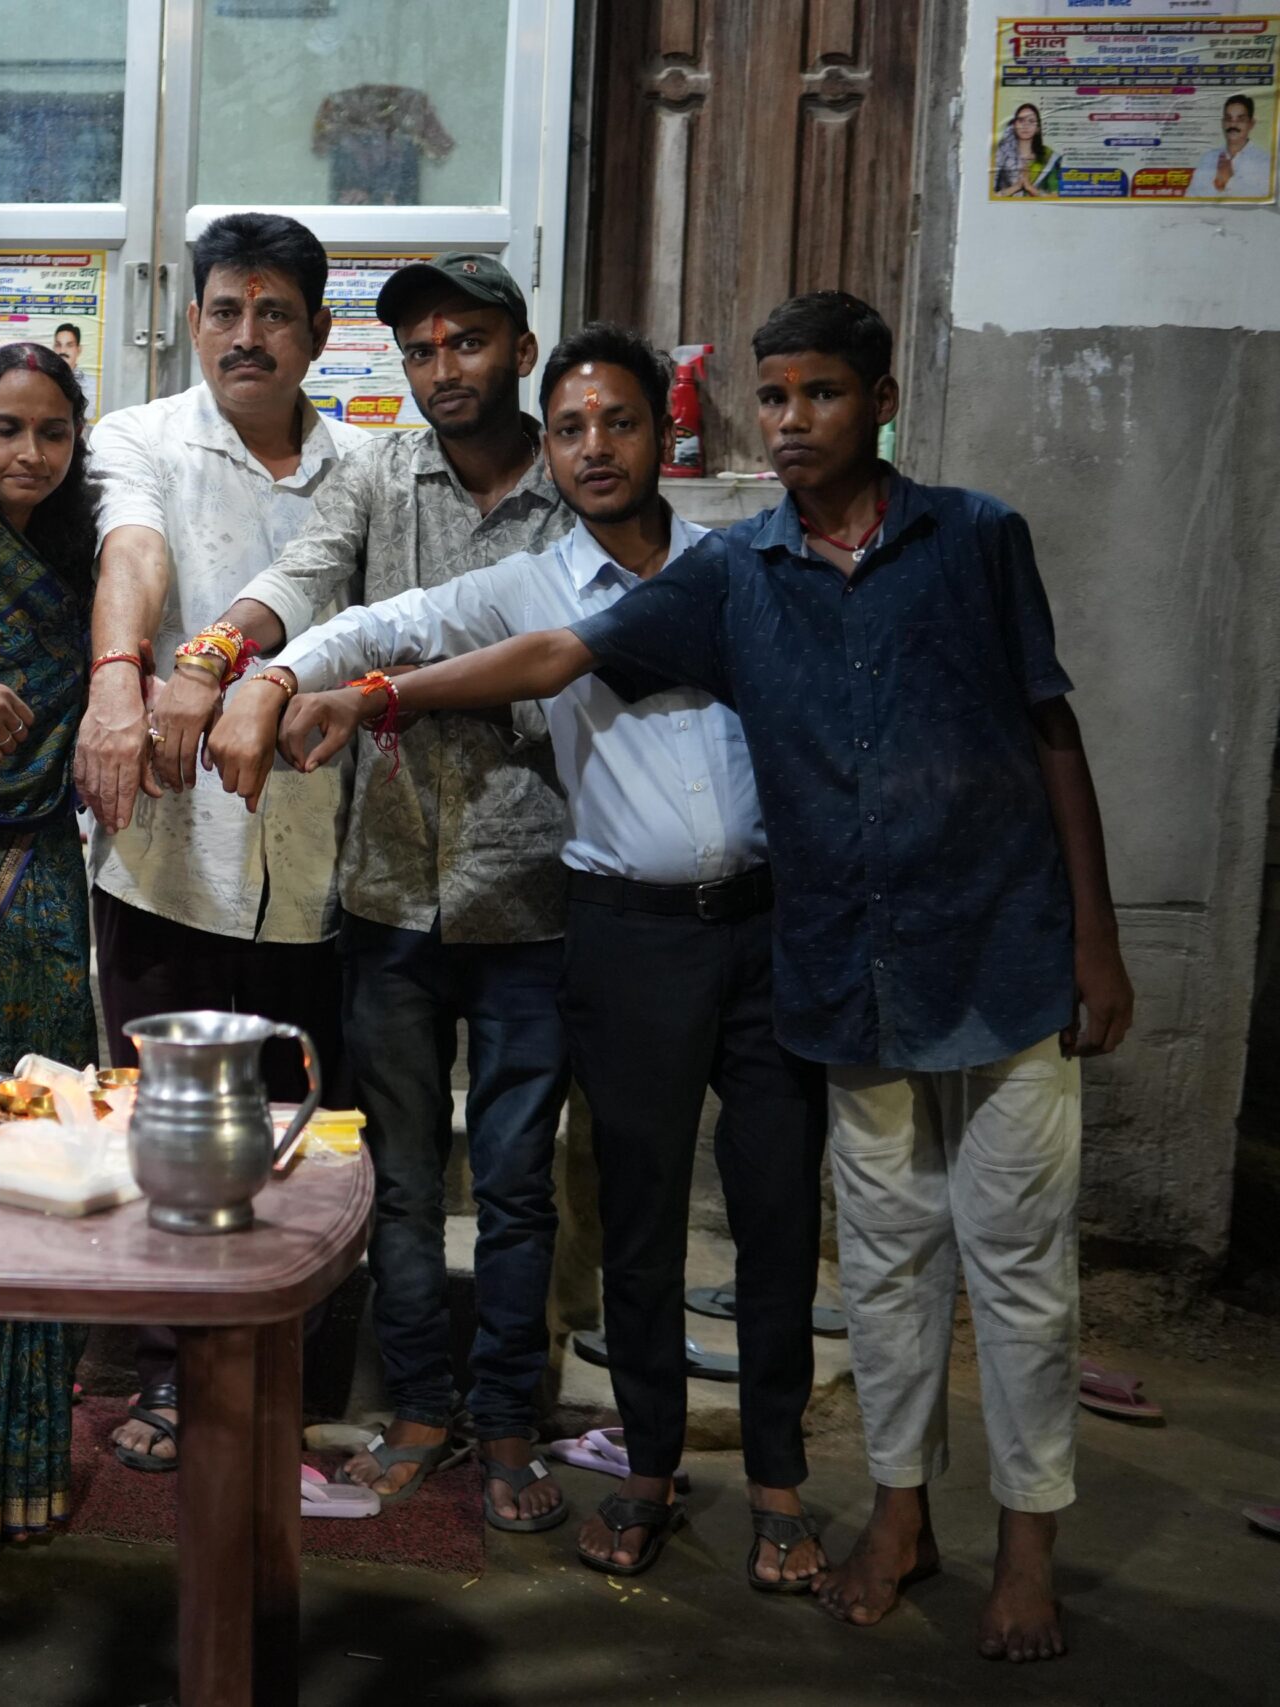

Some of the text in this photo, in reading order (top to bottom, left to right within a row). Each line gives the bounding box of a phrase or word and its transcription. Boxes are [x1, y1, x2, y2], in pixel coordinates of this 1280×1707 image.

[1009, 36, 1067, 57] 1 साल
[1236, 49, 1268, 60] इरादा
[64, 281, 91, 290] इरादा
